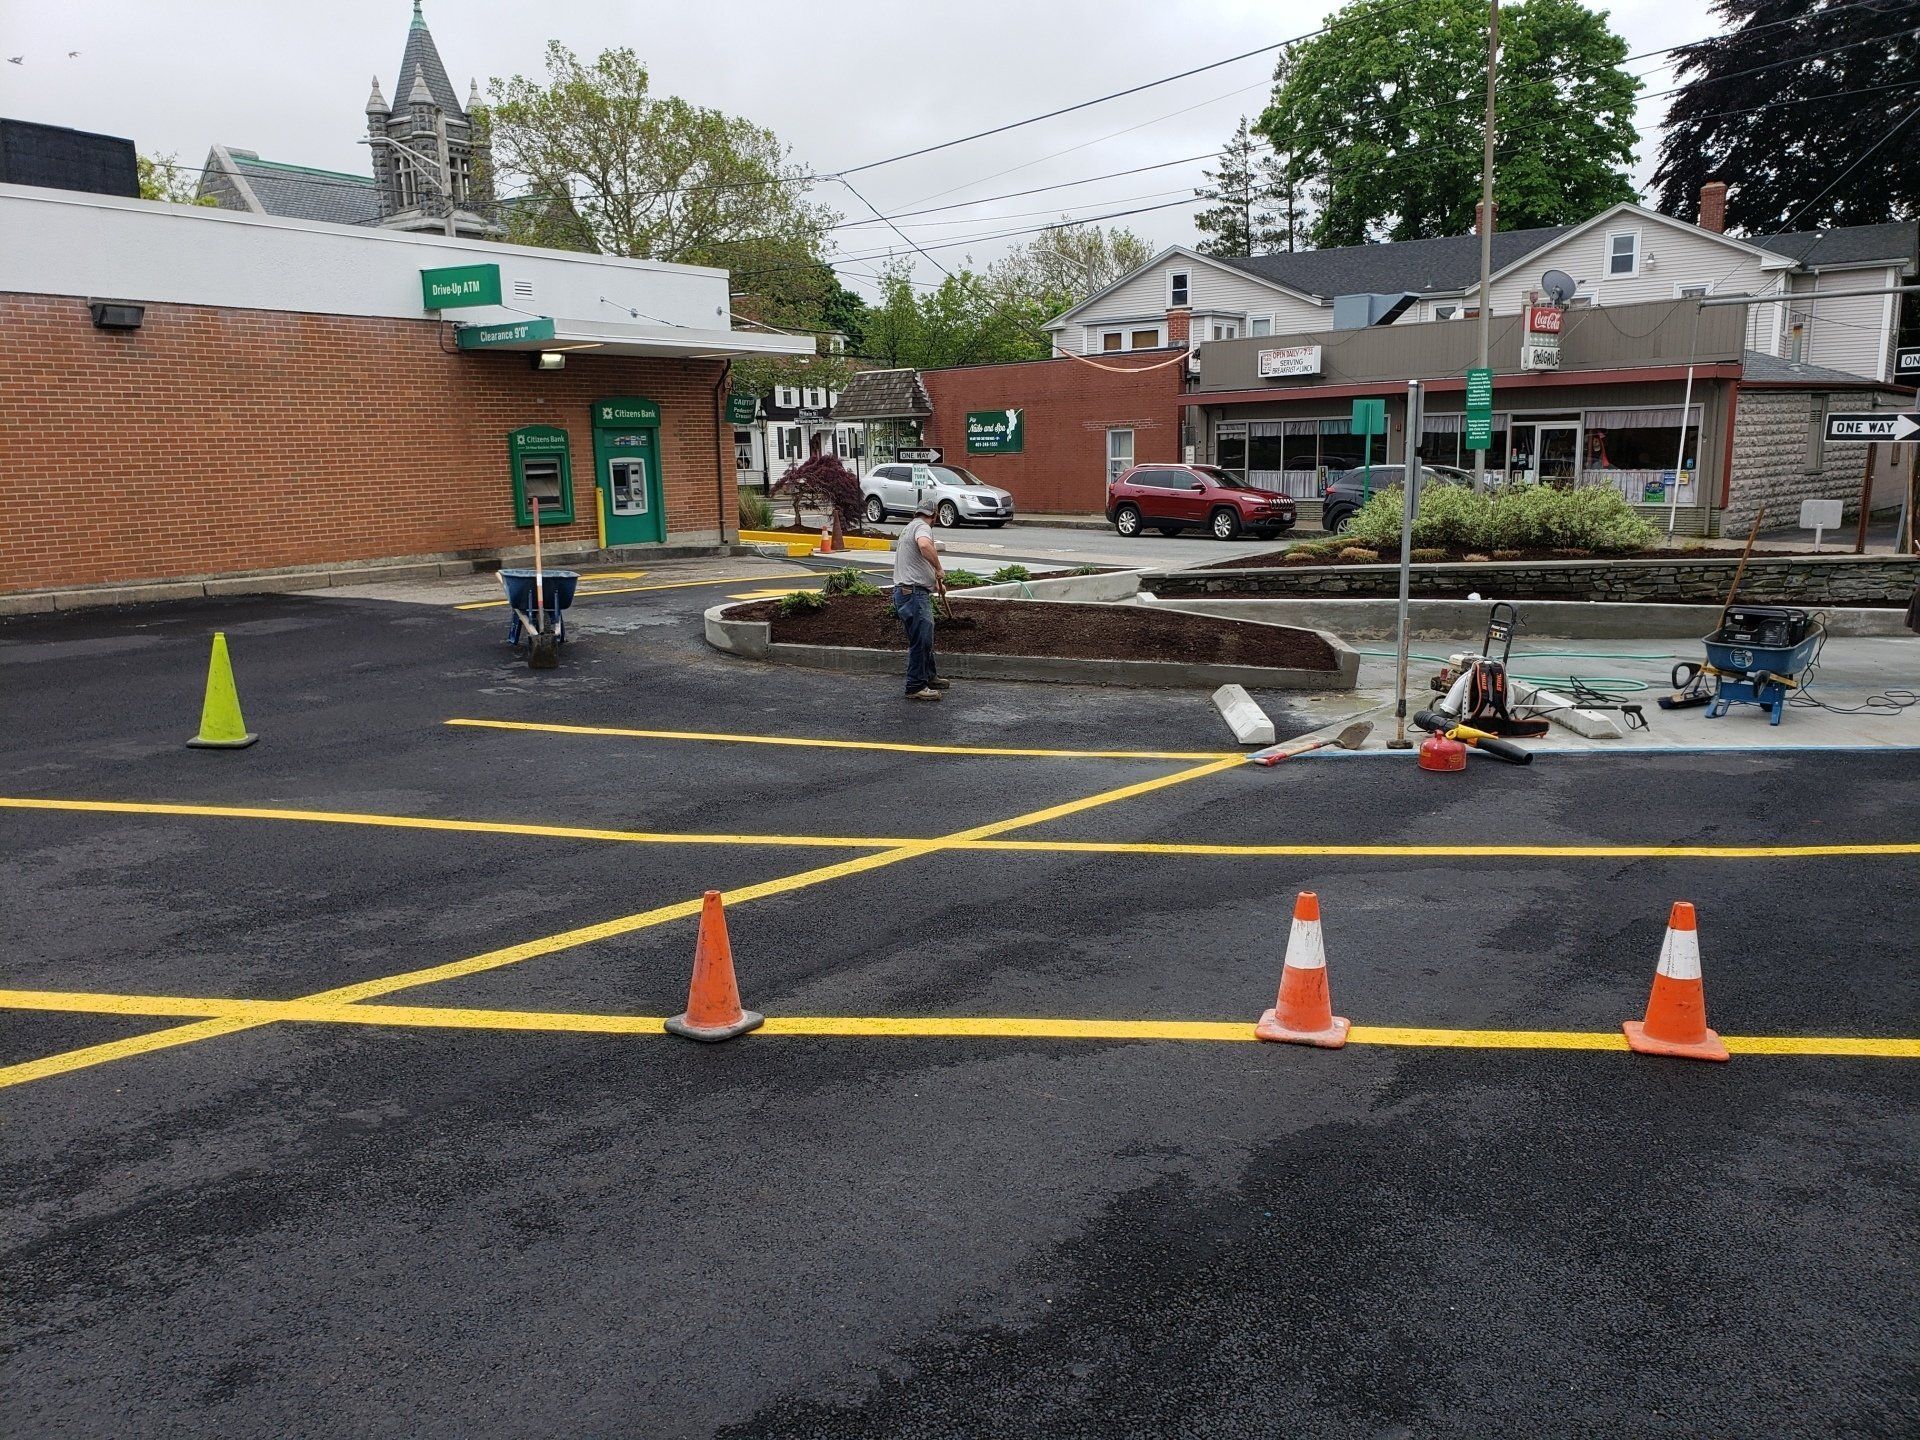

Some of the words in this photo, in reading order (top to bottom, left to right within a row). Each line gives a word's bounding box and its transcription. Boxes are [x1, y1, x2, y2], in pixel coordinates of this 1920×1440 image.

[432, 282, 462, 296] Drive-Up
[463, 280, 480, 293] ATM
[480, 330, 513, 342] Clearance
[514, 325, 529, 338] 9'0"
[1273, 351, 1285, 359] OPEN
[1904, 355, 1920, 366] ON
[1272, 366, 1296, 374] BREAKFAST
[614, 409, 641, 418] Citizens
[641, 409, 656, 418] Bank
[1836, 422, 1863, 433] ONE
[1868, 422, 1895, 433] WAY
[550, 435, 565, 443] Bank
